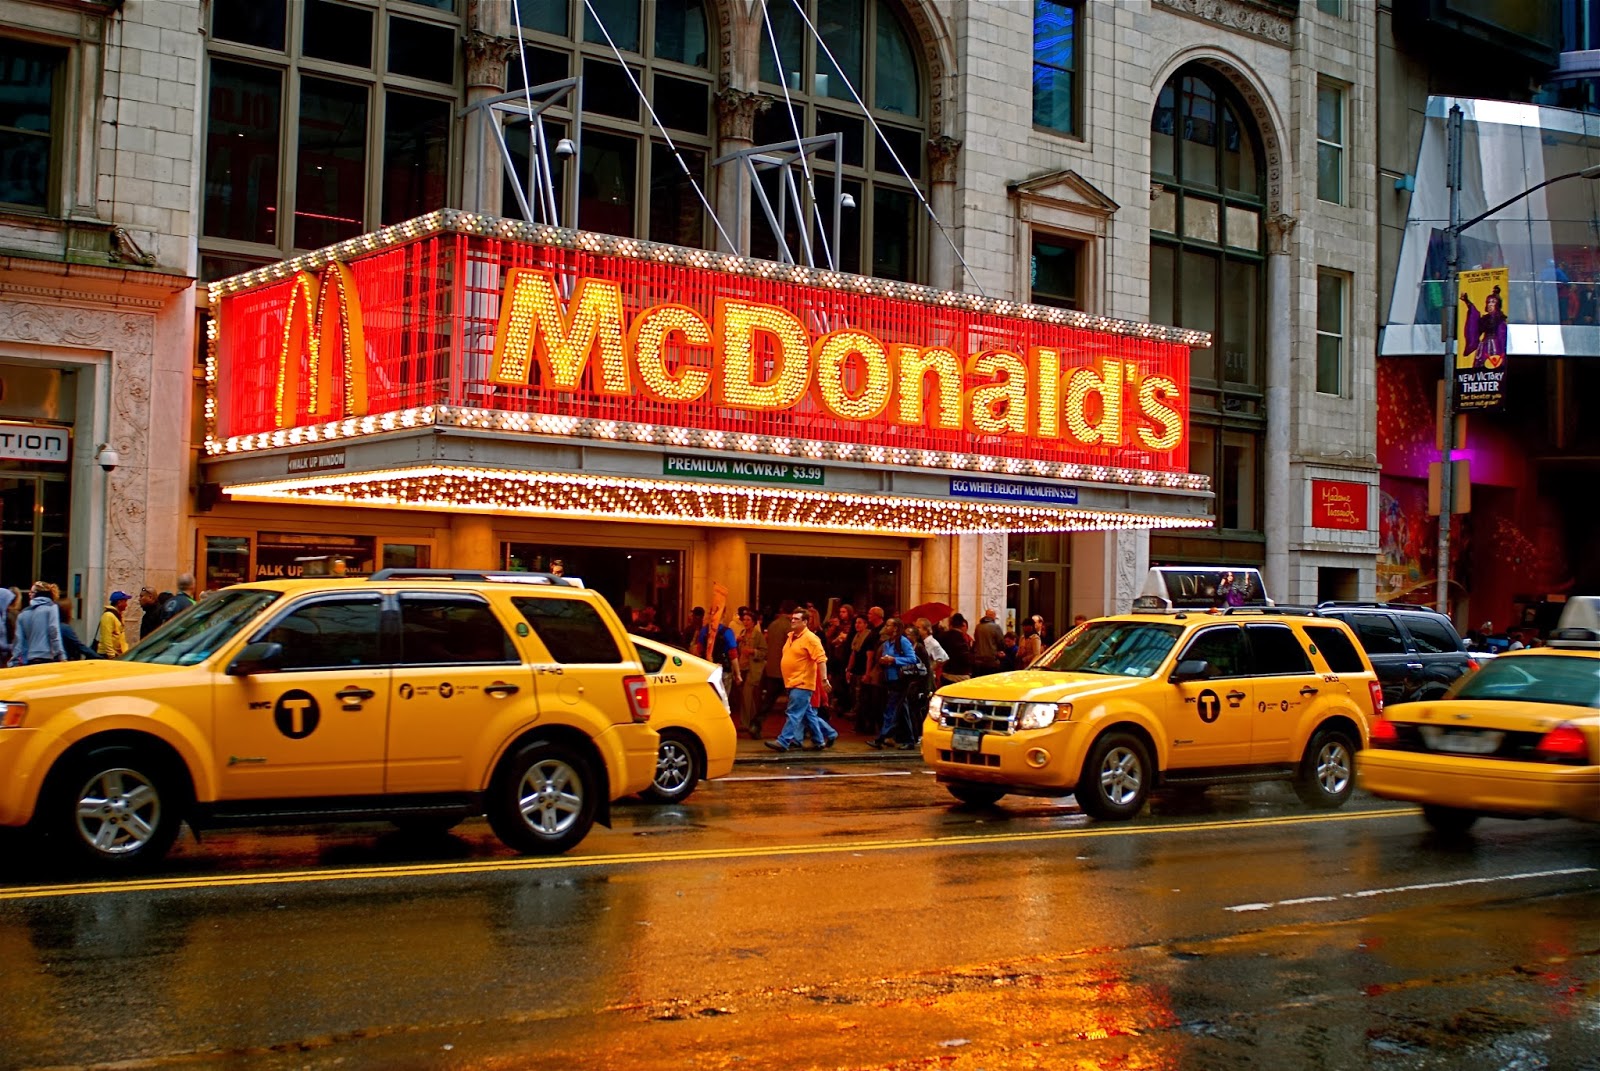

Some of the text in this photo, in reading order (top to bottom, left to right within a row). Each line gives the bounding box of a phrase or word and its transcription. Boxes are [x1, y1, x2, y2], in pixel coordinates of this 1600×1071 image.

[490, 267, 1184, 453] McDonald's
[1458, 371, 1504, 382] NEW VICTORY
[1463, 381, 1499, 393] THEATER
[291, 453, 345, 470] WALK UP WINDOW
[668, 457, 821, 479] PREMIUM MCWRAP $3.99
[952, 480, 968, 492] EGG
[969, 481, 992, 493] WHITE
[994, 483, 1023, 495] DELIGHT
[1024, 485, 1060, 498] McMUFFIN
[1322, 487, 1351, 502] Madame
[256, 565, 284, 577] ALK
[287, 566, 303, 577] UP
